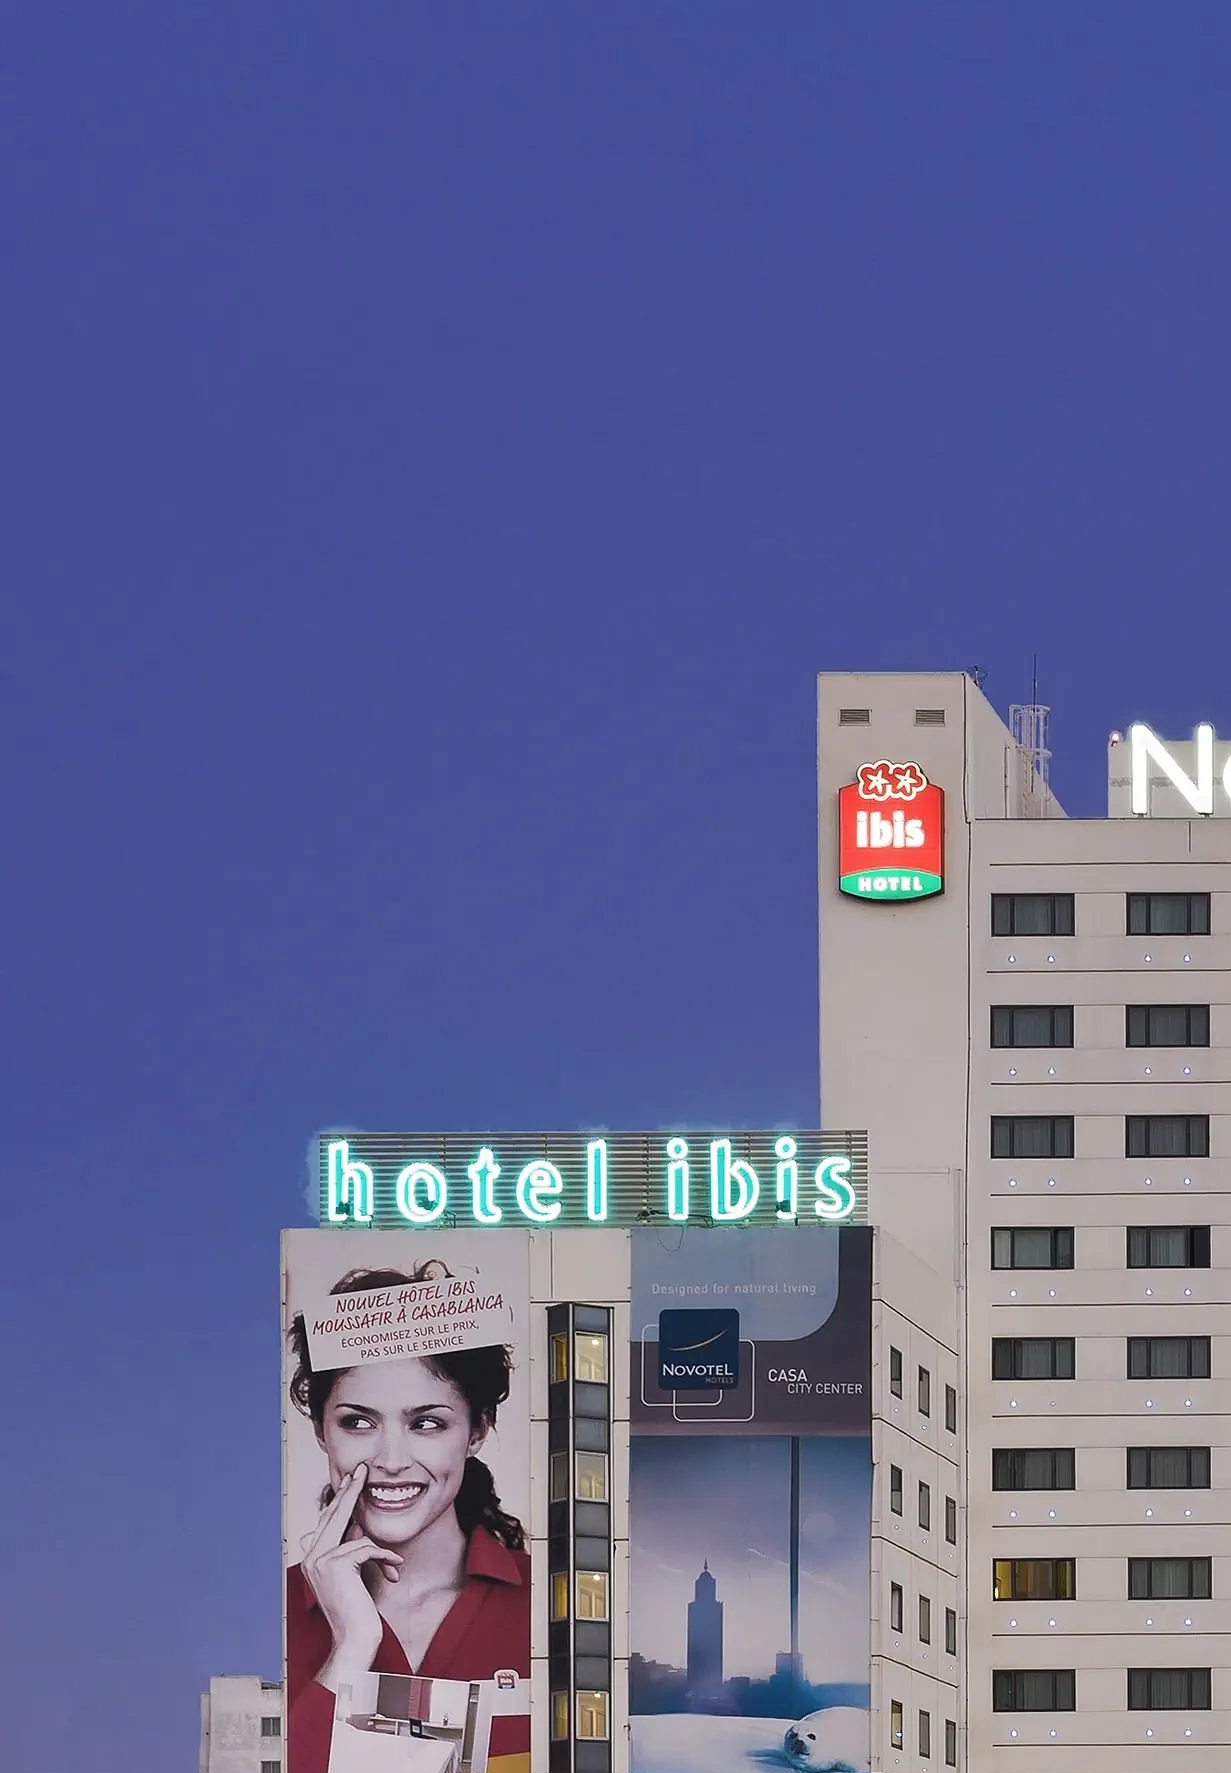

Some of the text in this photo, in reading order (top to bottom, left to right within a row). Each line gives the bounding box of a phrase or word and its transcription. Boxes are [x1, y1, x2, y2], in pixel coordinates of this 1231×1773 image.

[856, 810, 925, 849] ibis
[858, 877, 923, 892] HOTEL
[327, 1136, 858, 1223] hotel ibis
[336, 1280, 476, 1314] NOUVEL HÔTEL IBIS
[651, 1283, 817, 1297] Designed for natural living
[312, 1293, 504, 1336] MOUSSAFIR À CASABLANCA
[414, 1326, 435, 1338] SUR
[438, 1323, 449, 1335] LE
[453, 1319, 480, 1332] PRIX,
[360, 1335, 464, 1359] PAS SUR LE SERVICE
[768, 1368, 808, 1383] CASA
[787, 1383, 863, 1394] CITY CENTER
